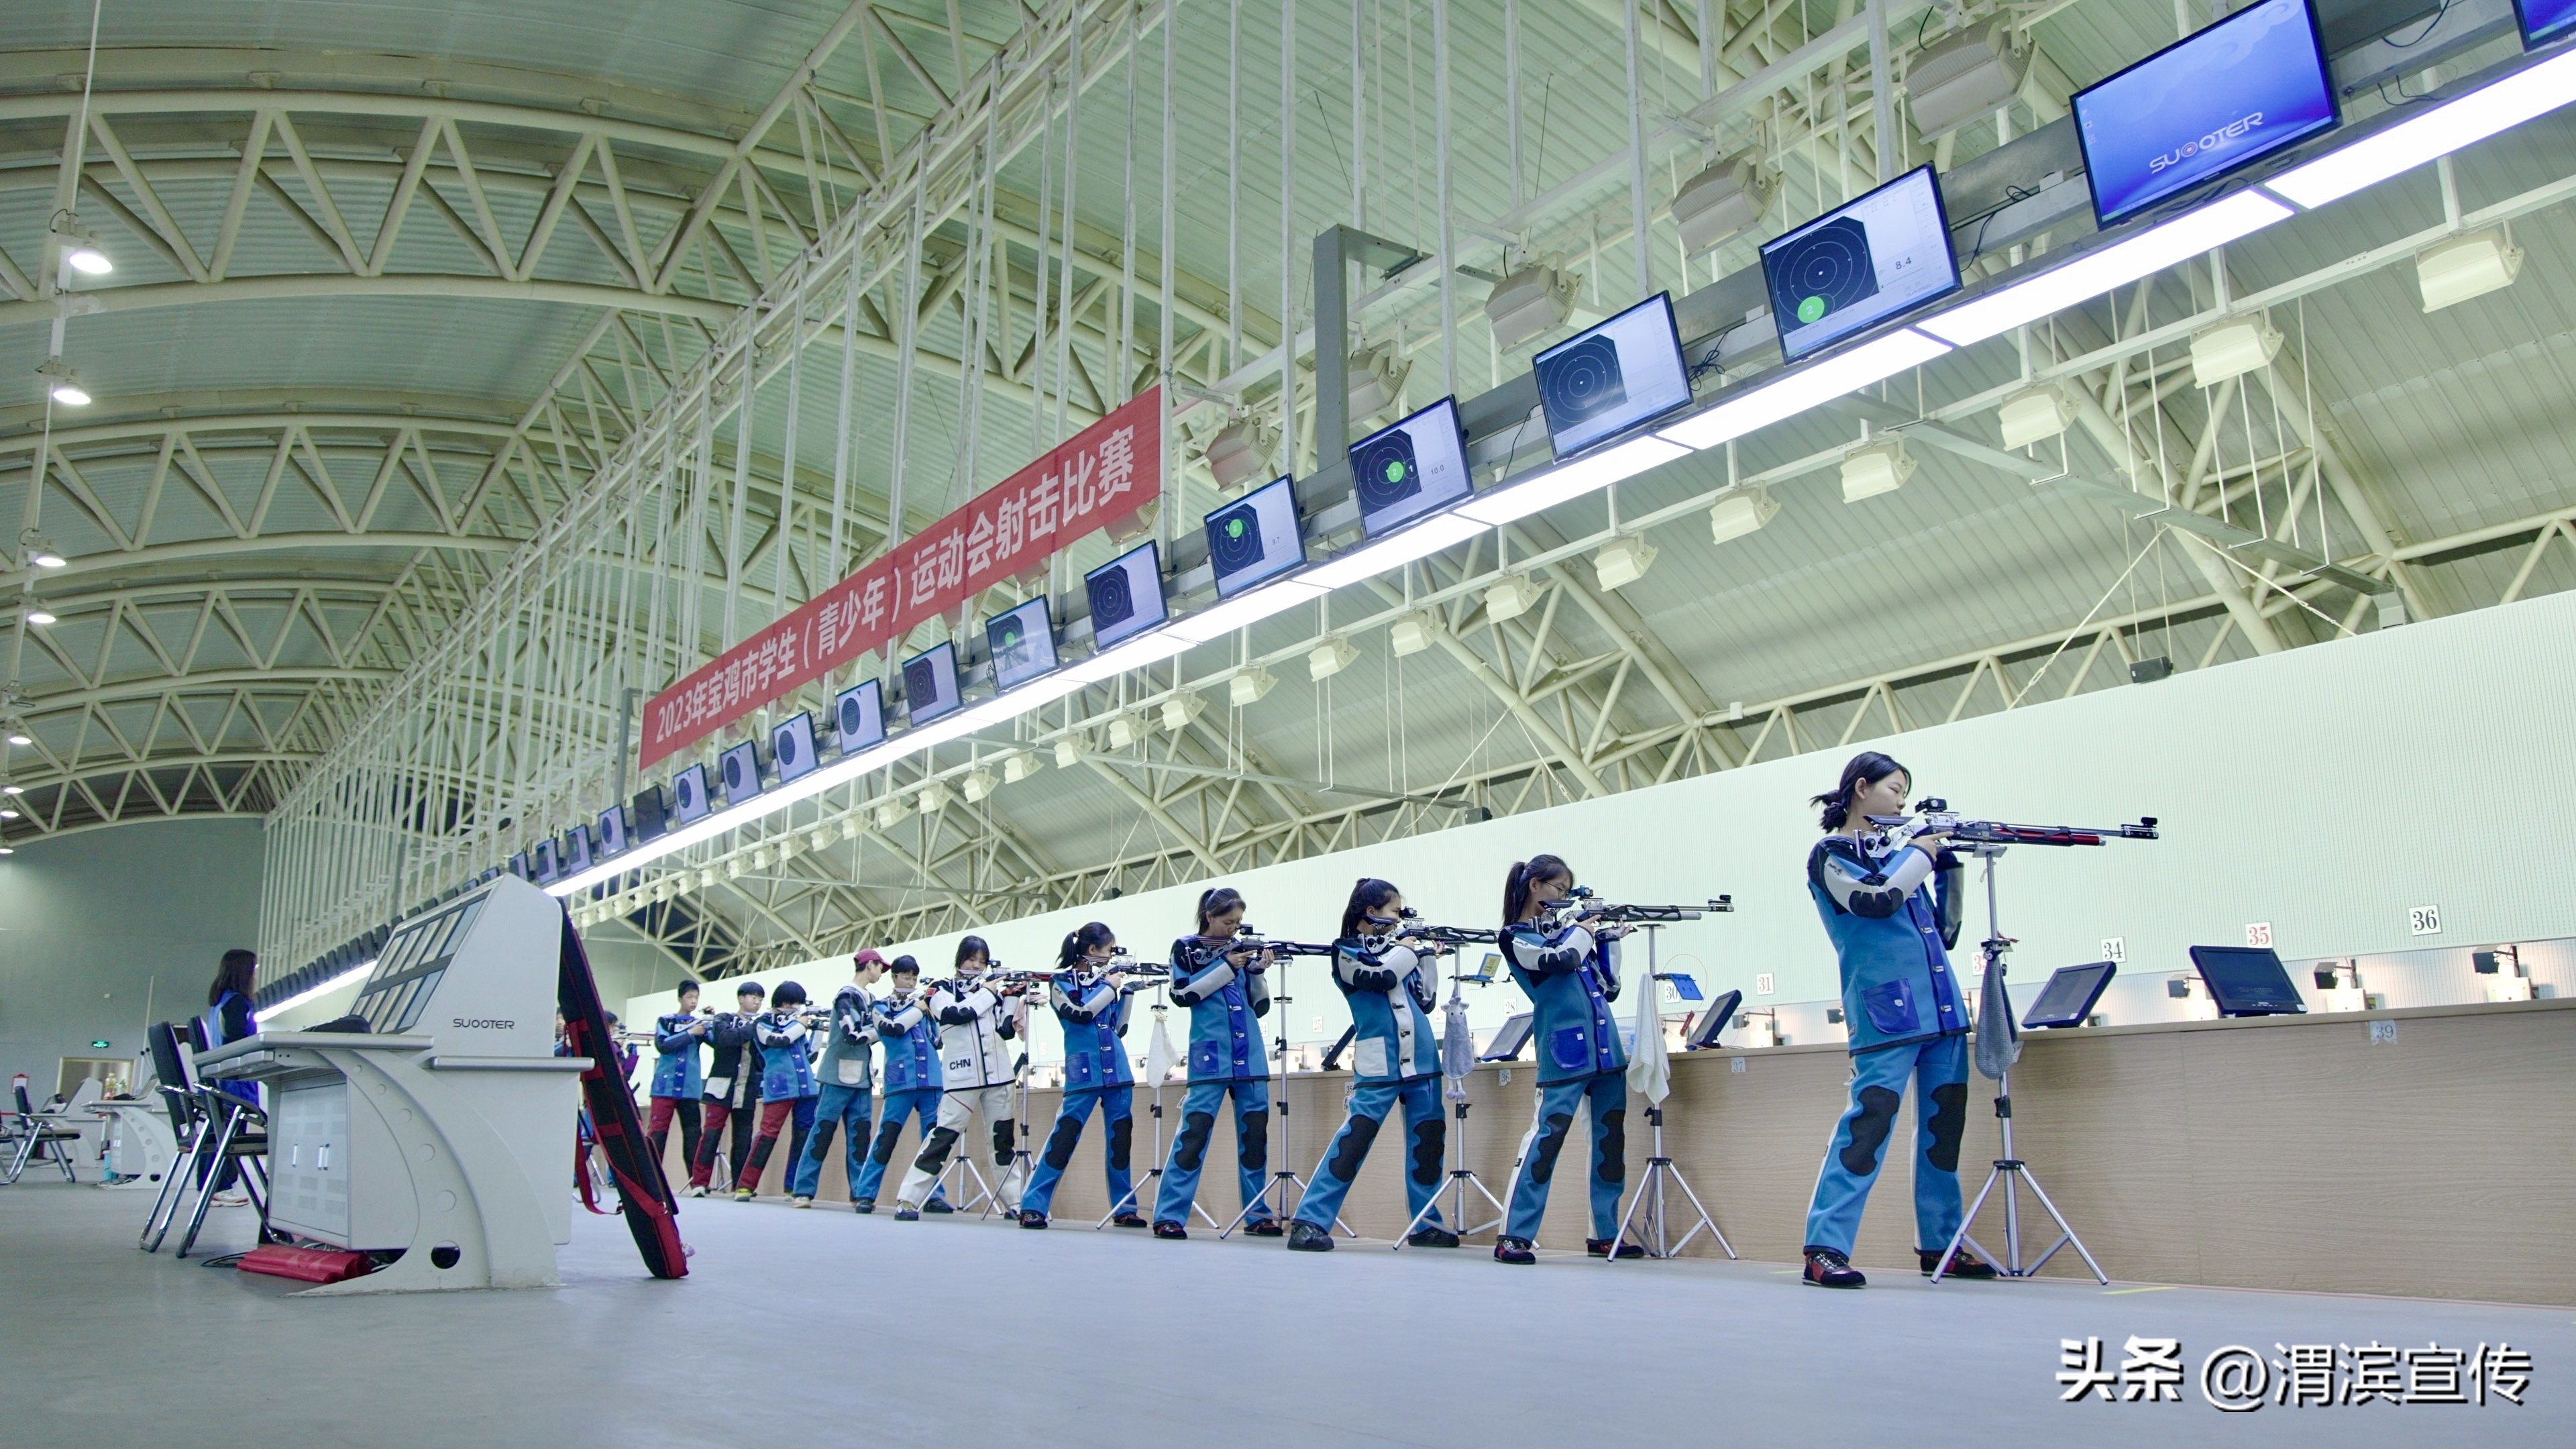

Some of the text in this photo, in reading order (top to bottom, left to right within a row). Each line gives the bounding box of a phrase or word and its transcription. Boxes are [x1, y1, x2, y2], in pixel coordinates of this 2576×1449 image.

[1895, 256, 1912, 270] 8.4
[1806, 306, 1814, 315] 2
[1392, 468, 1397, 476] 2
[1430, 464, 1444, 476] 10.0
[1272, 536, 1281, 545] 9.7
[2413, 909, 2437, 931] 36
[2249, 926, 2269, 946] 35
[2104, 941, 2123, 960] 34
[1758, 977, 1772, 992] 31
[1666, 985, 1678, 1000] 30
[1505, 1000, 1515, 1014] 28
[453, 1018, 515, 1030] SUOOTER
[1313, 1018, 1322, 1031] 25
[2376, 1024, 2394, 1039] 39
[949, 1058, 971, 1071] CHN
[1733, 1061, 1743, 1072] 37
[1501, 1073, 1509, 1082] 36
[1346, 1085, 1353, 1093] 35
